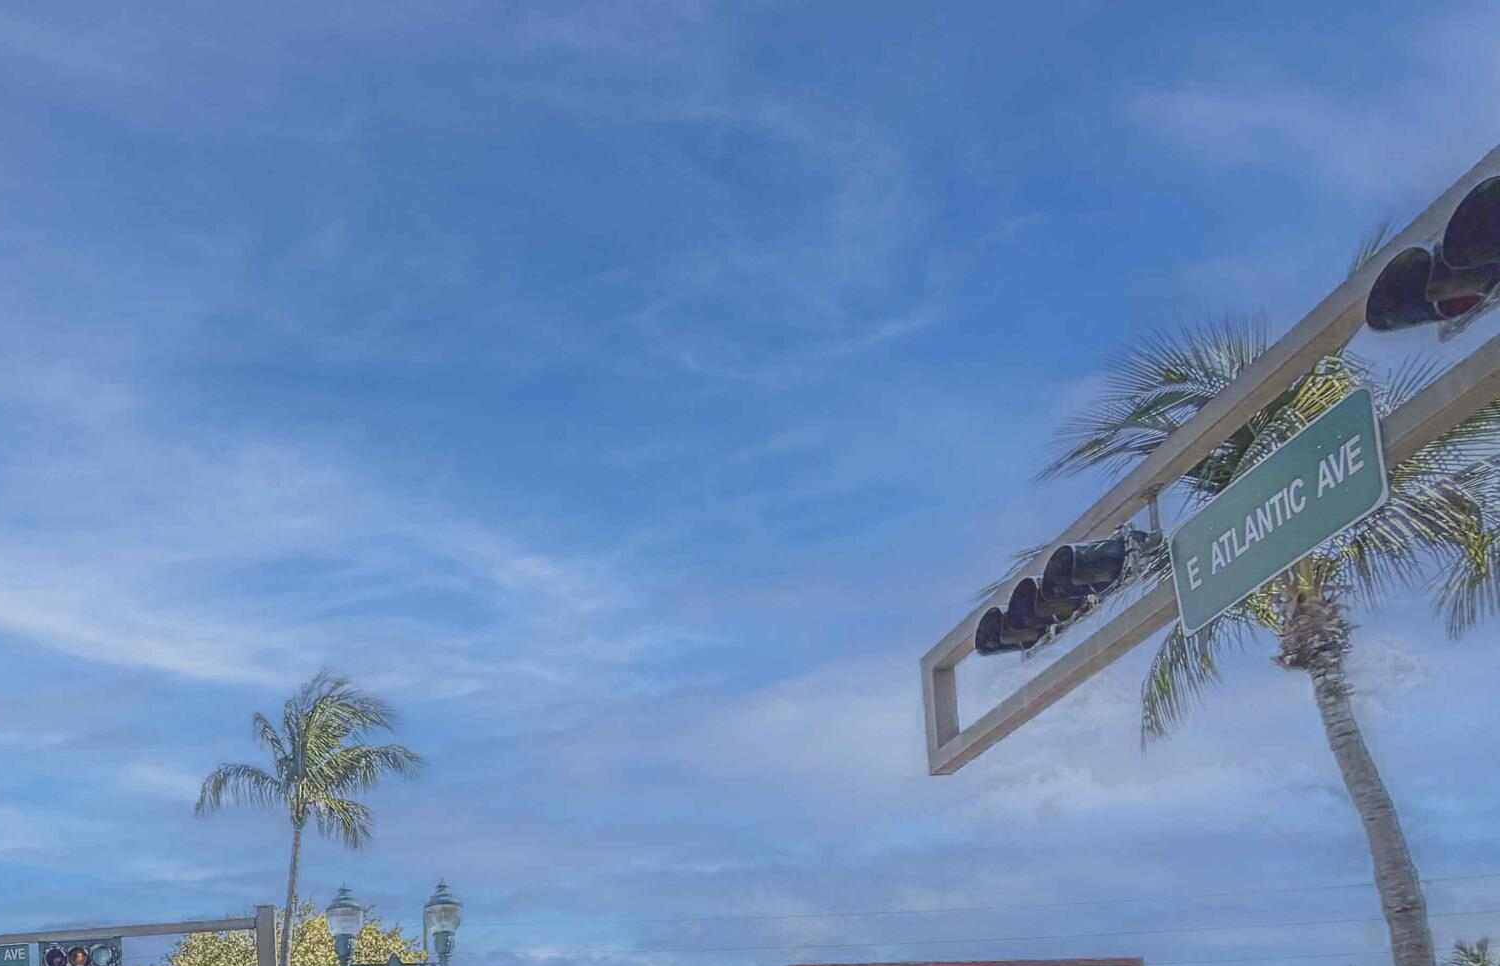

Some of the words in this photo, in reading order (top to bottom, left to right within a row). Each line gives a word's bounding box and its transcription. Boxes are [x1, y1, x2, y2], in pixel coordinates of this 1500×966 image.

[1186, 556, 1203, 590] E
[1211, 478, 1306, 575] ATLANTIC
[1317, 434, 1365, 498] AVE
[4, 948, 26, 960] AVE
